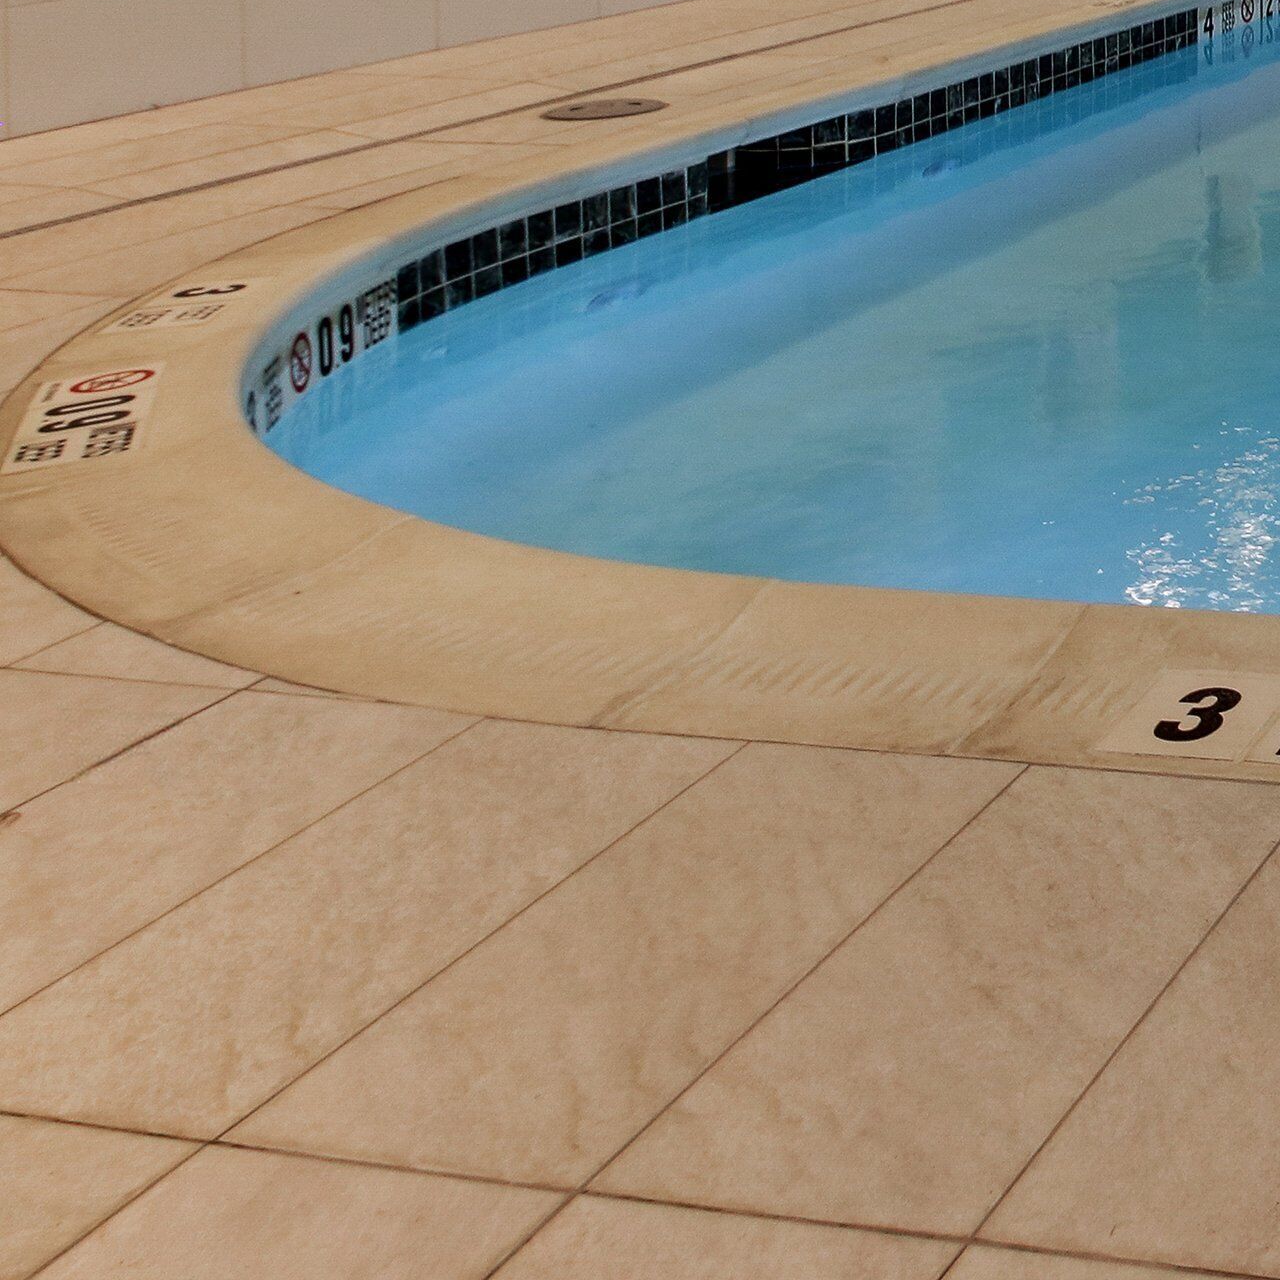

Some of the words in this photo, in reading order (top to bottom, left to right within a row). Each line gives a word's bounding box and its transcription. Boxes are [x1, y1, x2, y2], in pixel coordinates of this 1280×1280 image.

[1203, 7, 1214, 39] 4
[172, 283, 248, 298] 3
[1153, 686, 1242, 743] 3
